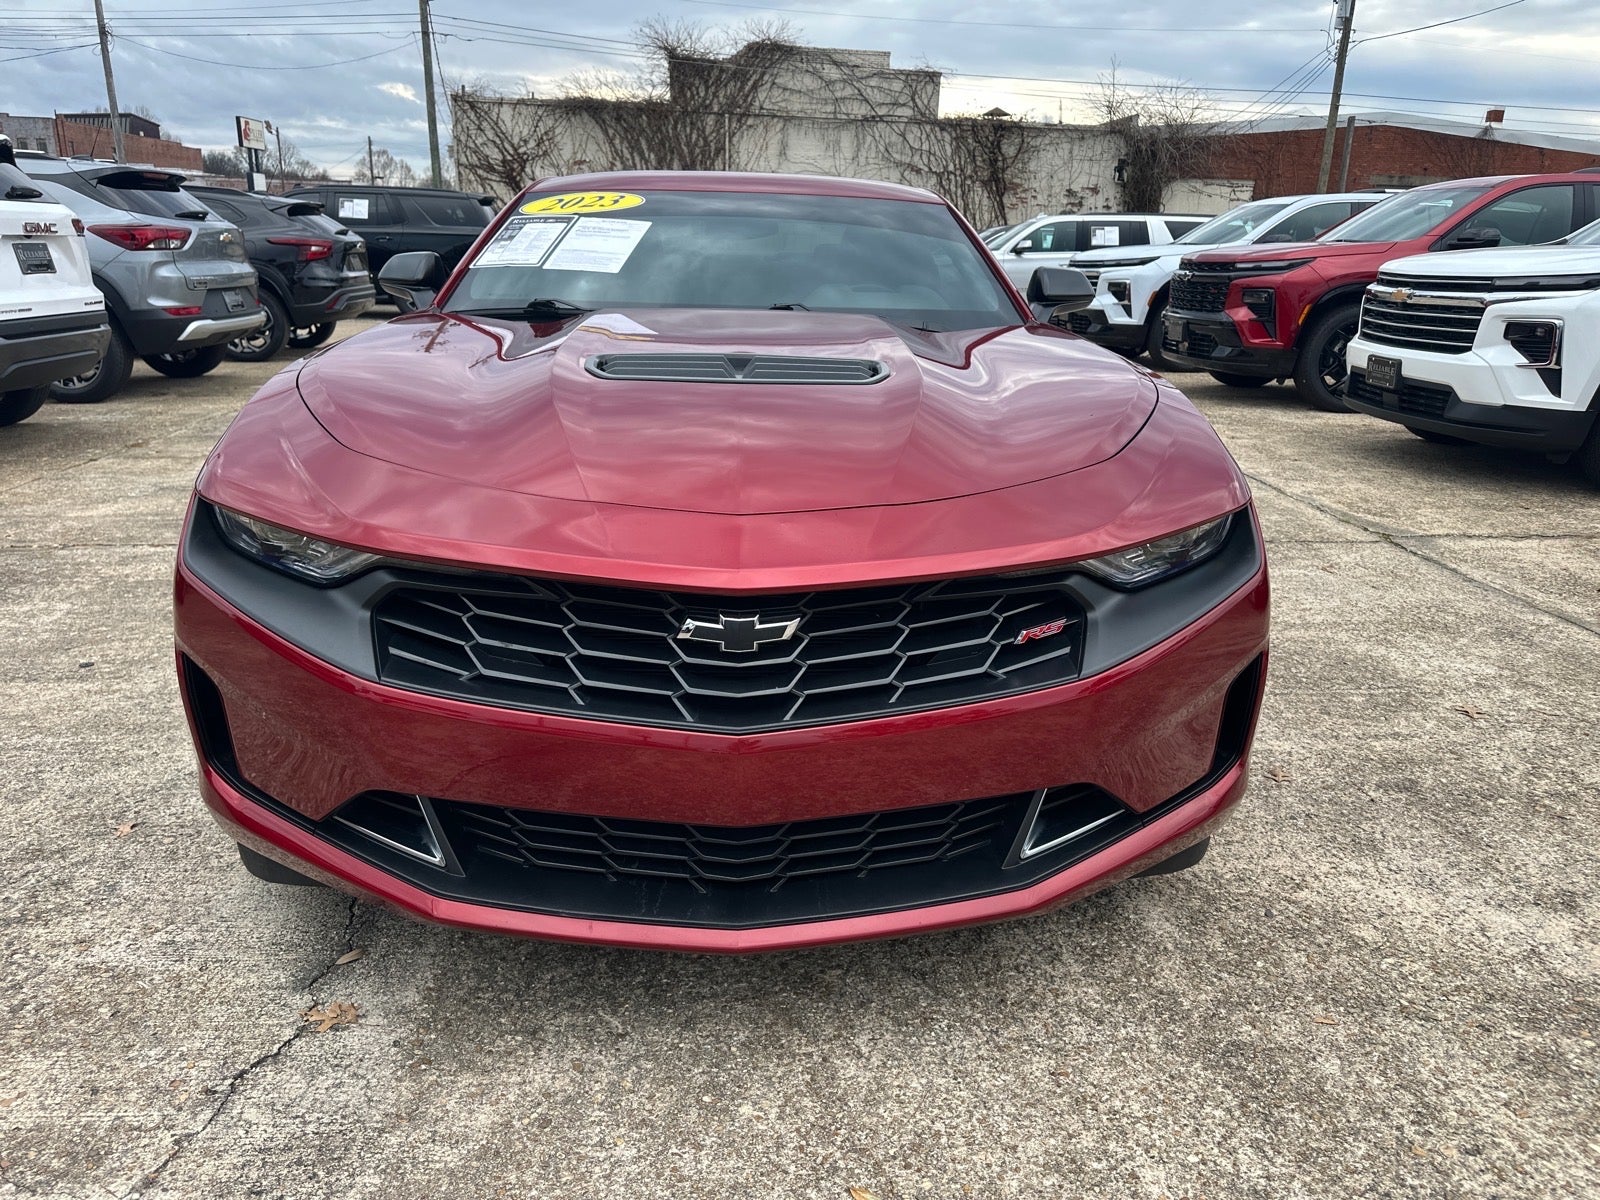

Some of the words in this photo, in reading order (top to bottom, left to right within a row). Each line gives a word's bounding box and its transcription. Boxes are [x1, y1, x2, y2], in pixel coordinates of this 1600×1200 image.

[537, 195, 626, 212] 2023
[22, 222, 58, 234] GMC
[17, 249, 51, 260] RELIABLE
[1368, 361, 1395, 376] RELIABLE
[1014, 618, 1067, 645] RS
